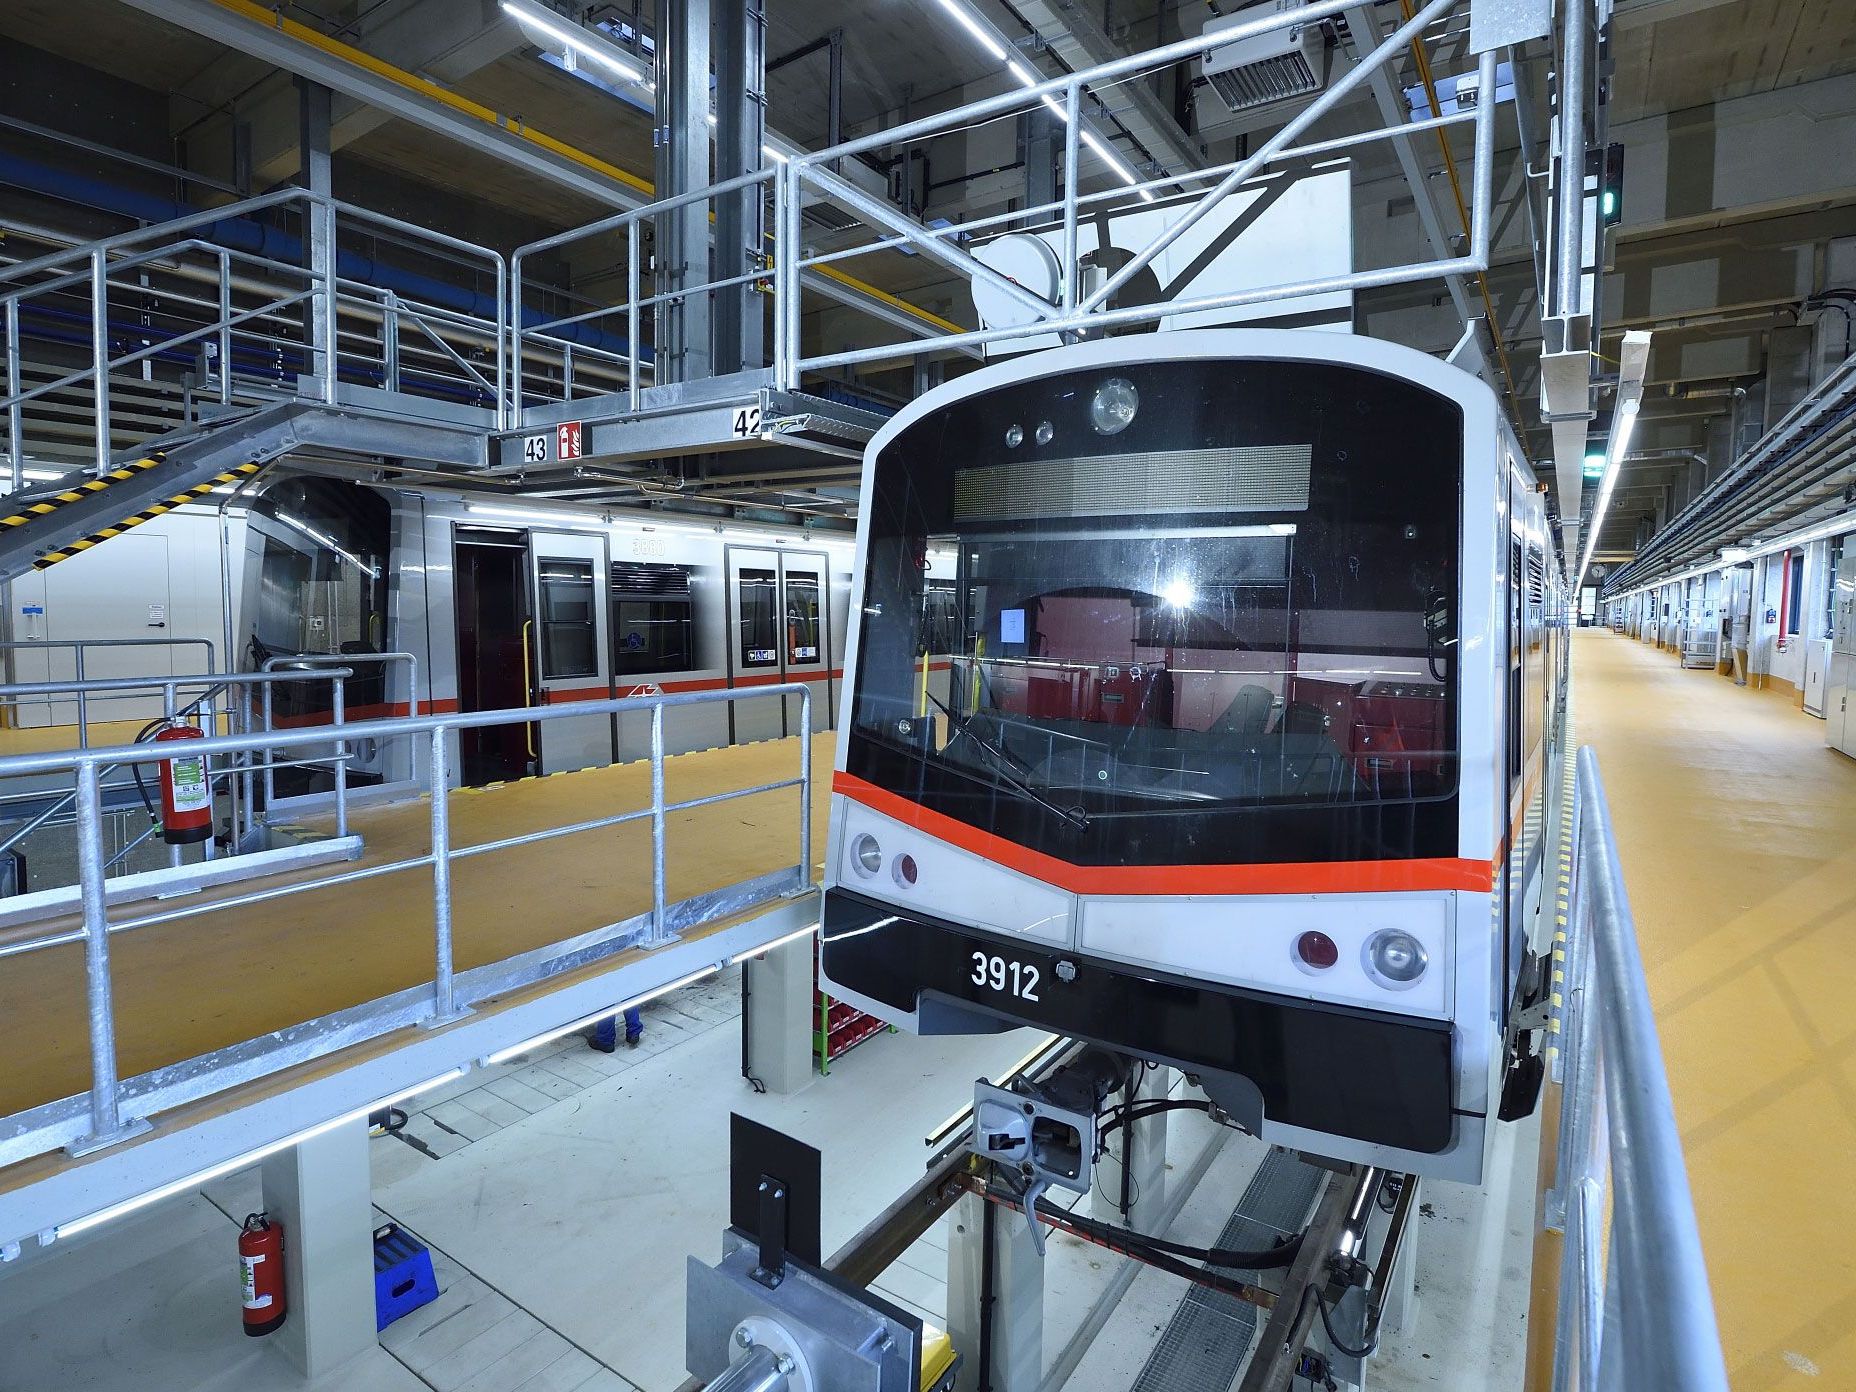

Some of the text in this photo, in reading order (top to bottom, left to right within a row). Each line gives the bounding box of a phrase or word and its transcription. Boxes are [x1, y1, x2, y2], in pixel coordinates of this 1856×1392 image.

[735, 409, 759, 436] 42
[526, 438, 545, 460] 43
[971, 951, 1040, 1002] 3912
